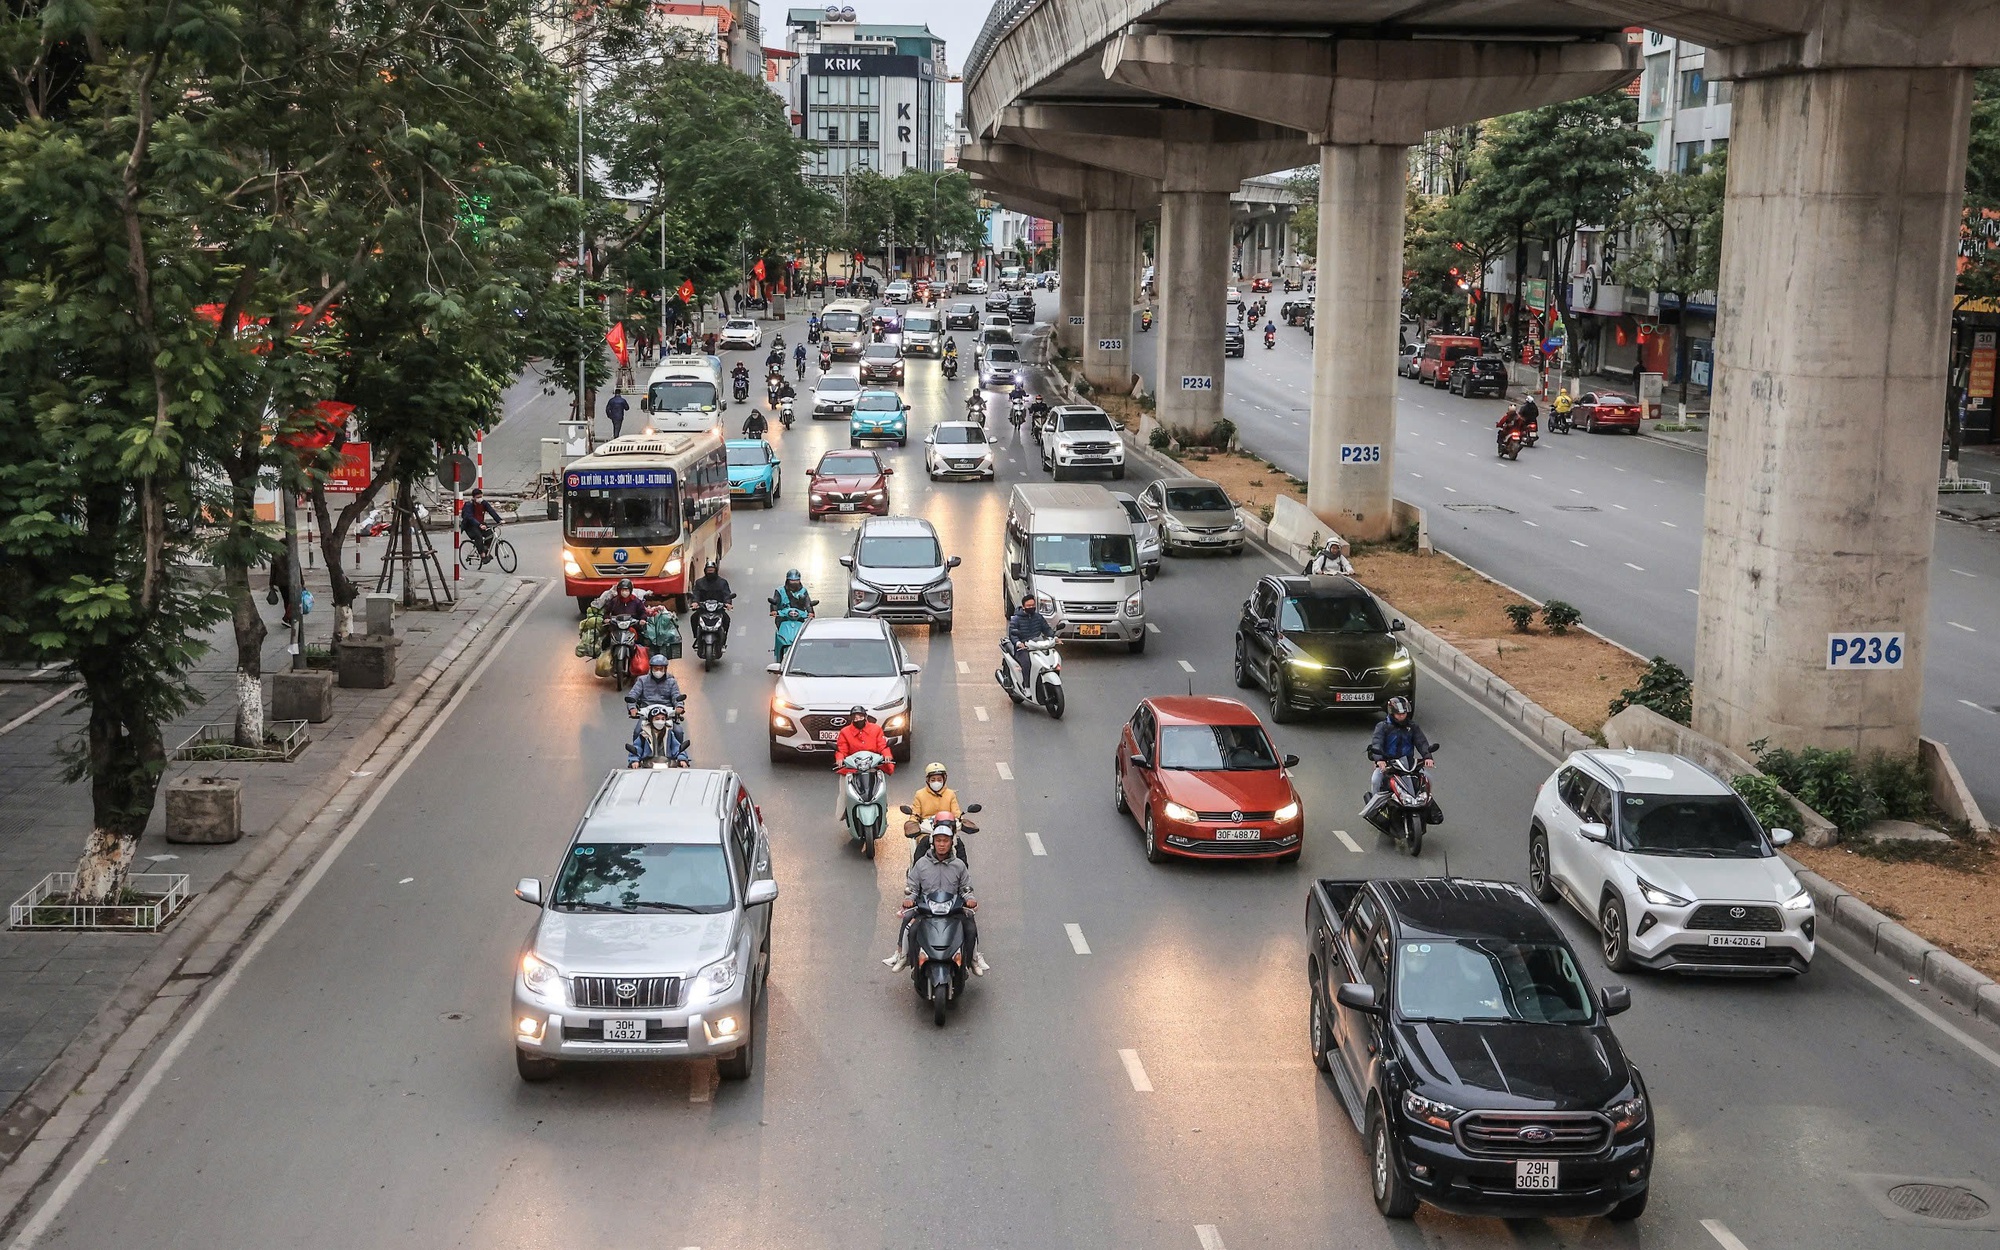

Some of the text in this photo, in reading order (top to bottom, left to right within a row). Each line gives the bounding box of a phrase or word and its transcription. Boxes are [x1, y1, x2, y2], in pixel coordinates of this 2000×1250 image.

[825, 59, 861, 71] KRIK
[1099, 340, 1121, 349] P233
[1979, 334, 1993, 343] 30
[1183, 377, 1211, 389] P234
[1342, 446, 1380, 462] P235
[1831, 637, 1901, 665] P236
[1713, 937, 1761, 946] 81A-420.64
[615, 1021, 634, 1030] 30H
[609, 1030, 641, 1039] 149.27
[1526, 1162, 1549, 1175] 29H
[1517, 1175, 1556, 1188] 305.61
